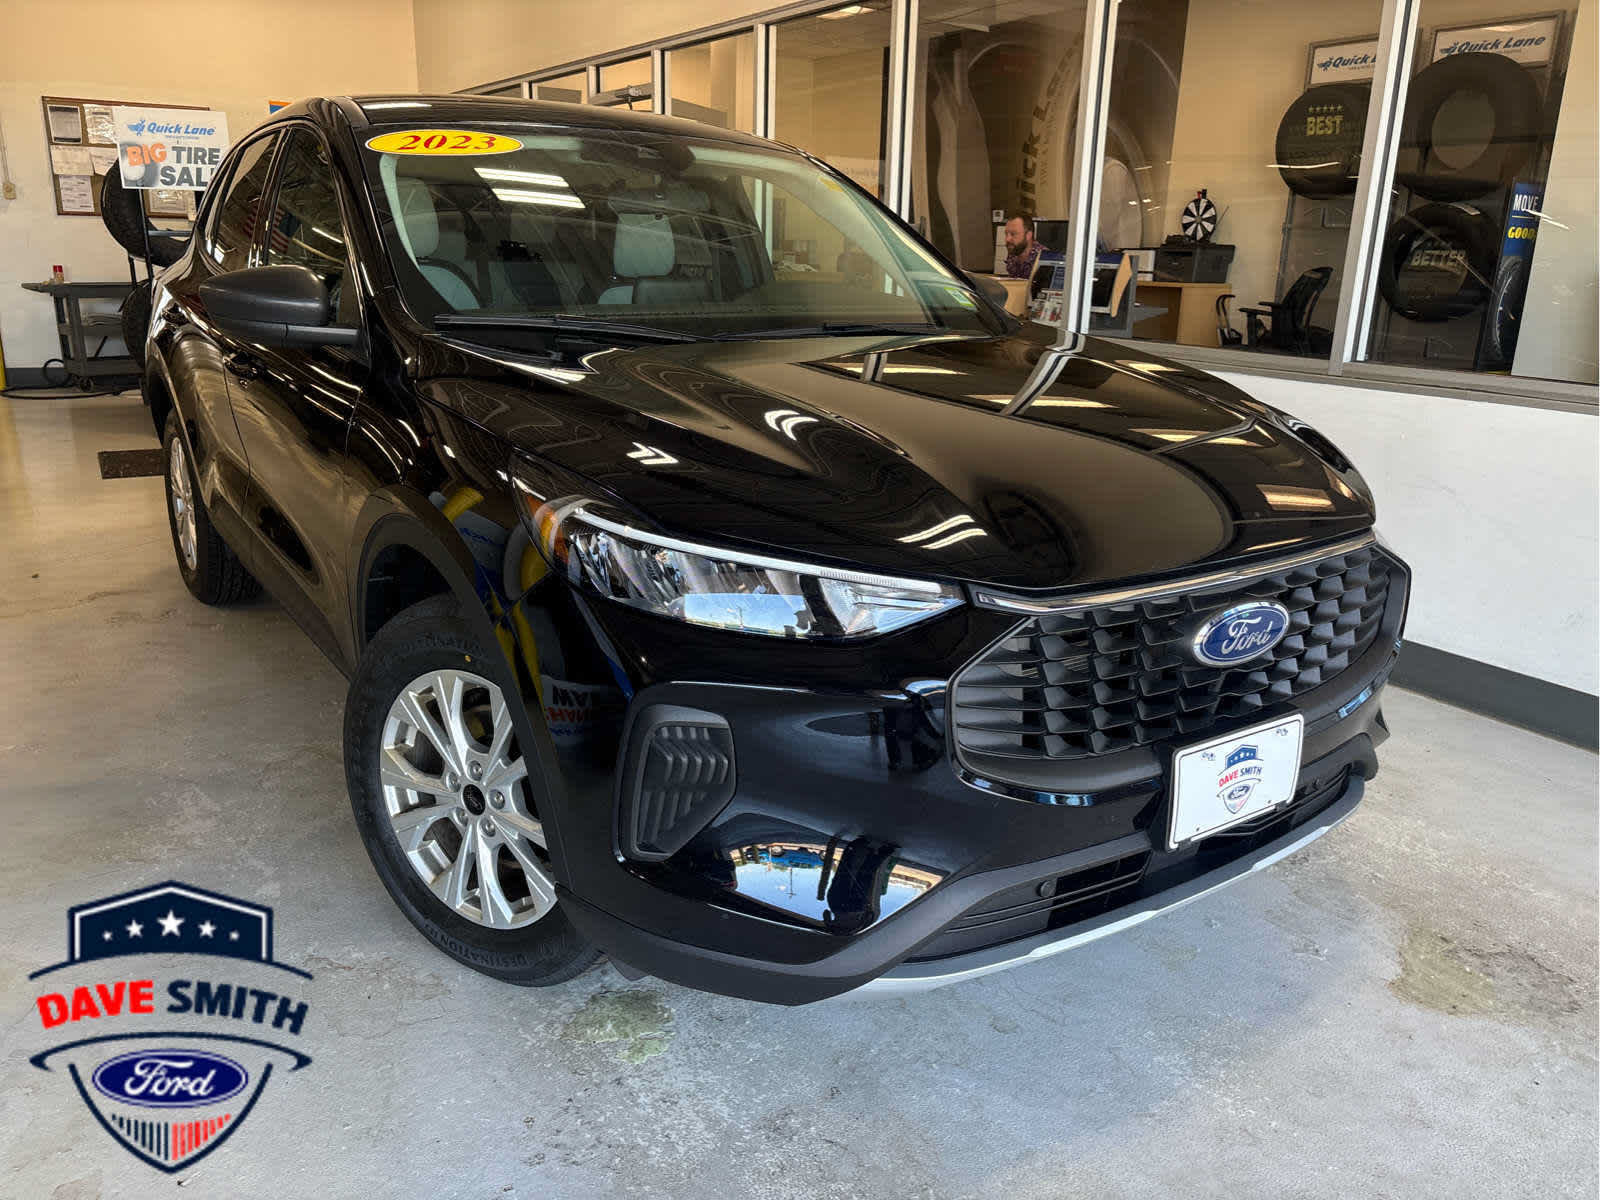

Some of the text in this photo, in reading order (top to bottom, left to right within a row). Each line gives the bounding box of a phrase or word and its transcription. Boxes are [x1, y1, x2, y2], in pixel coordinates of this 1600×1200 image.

[1458, 36, 1546, 54] Quick Lane
[1332, 54, 1371, 68] Quick
[147, 122, 216, 136] Quick Lane
[1306, 115, 1344, 136] BEST
[397, 135, 497, 150] 2023
[126, 142, 221, 167] BIG TIRE
[160, 165, 214, 188] SAL
[1513, 194, 1540, 212] MOVE
[1507, 226, 1537, 240] GOOD
[1410, 249, 1469, 267] BETTER
[1222, 616, 1273, 654] Ford
[1218, 766, 1263, 788] DAVE SMITH
